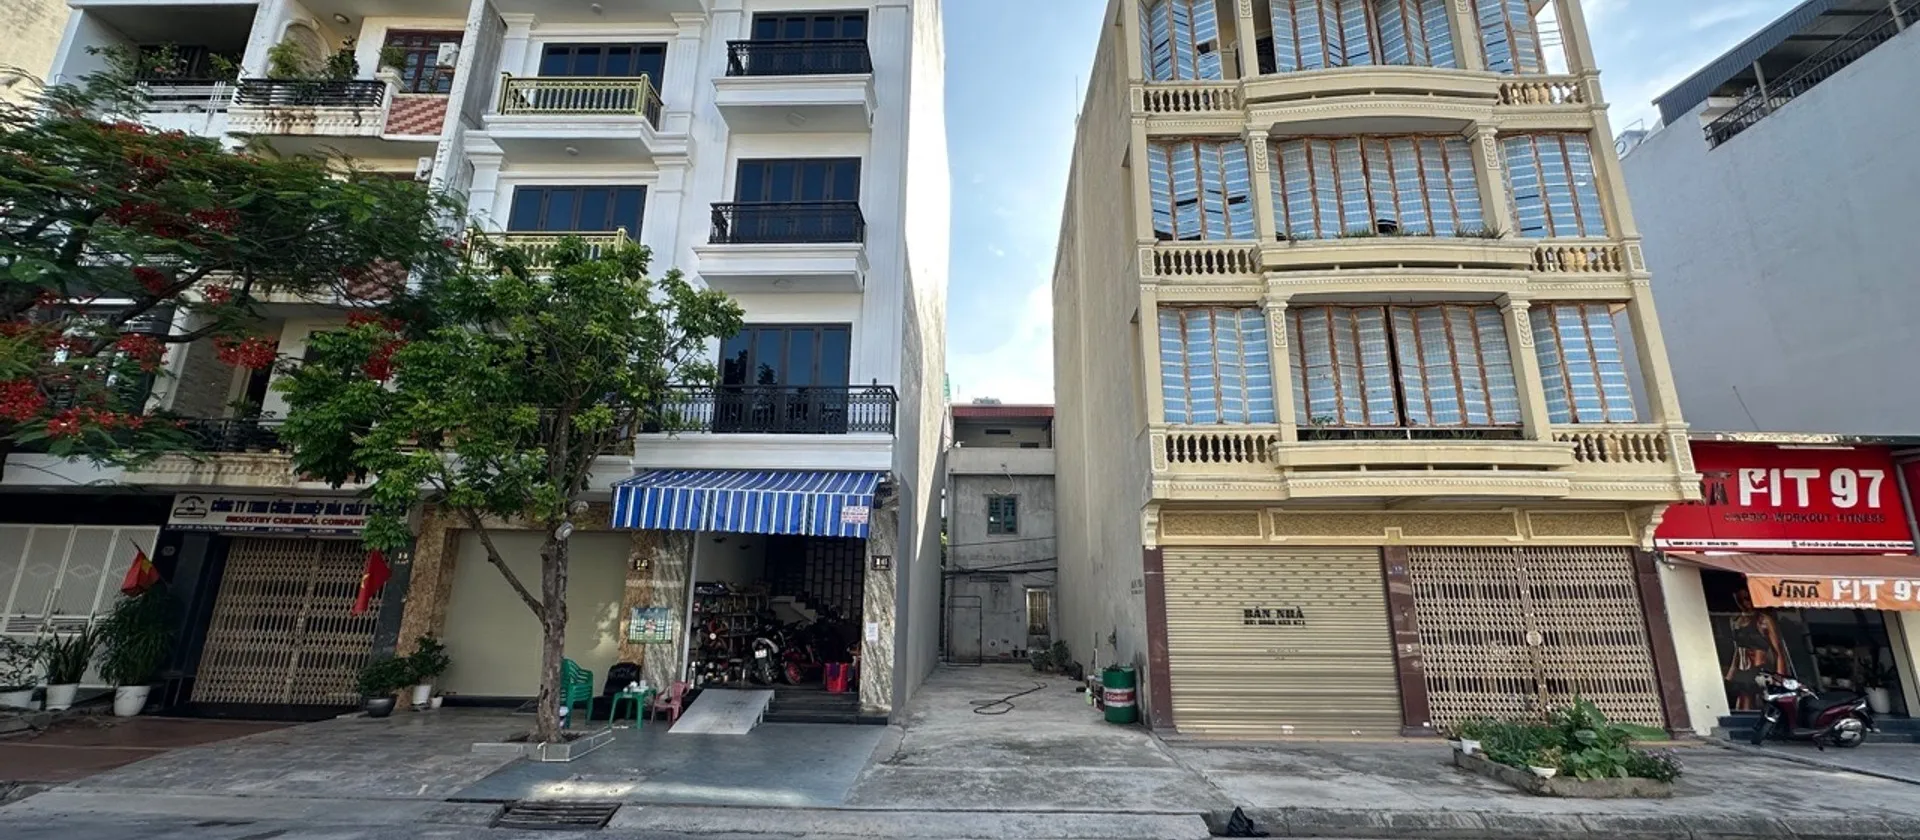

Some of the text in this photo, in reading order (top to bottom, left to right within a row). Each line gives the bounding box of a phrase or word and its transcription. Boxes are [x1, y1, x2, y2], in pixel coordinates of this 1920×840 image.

[1738, 467, 1820, 507] FIT
[1830, 468, 1885, 508] 97
[226, 515, 271, 524] INDUSTRY
[272, 516, 319, 525] CHEMICAL
[1773, 513, 1830, 523] WORKOUT
[1771, 579, 1819, 598] VINA
[1832, 579, 1885, 601] FIT
[1244, 605, 1304, 618] BÁN NHÀ
